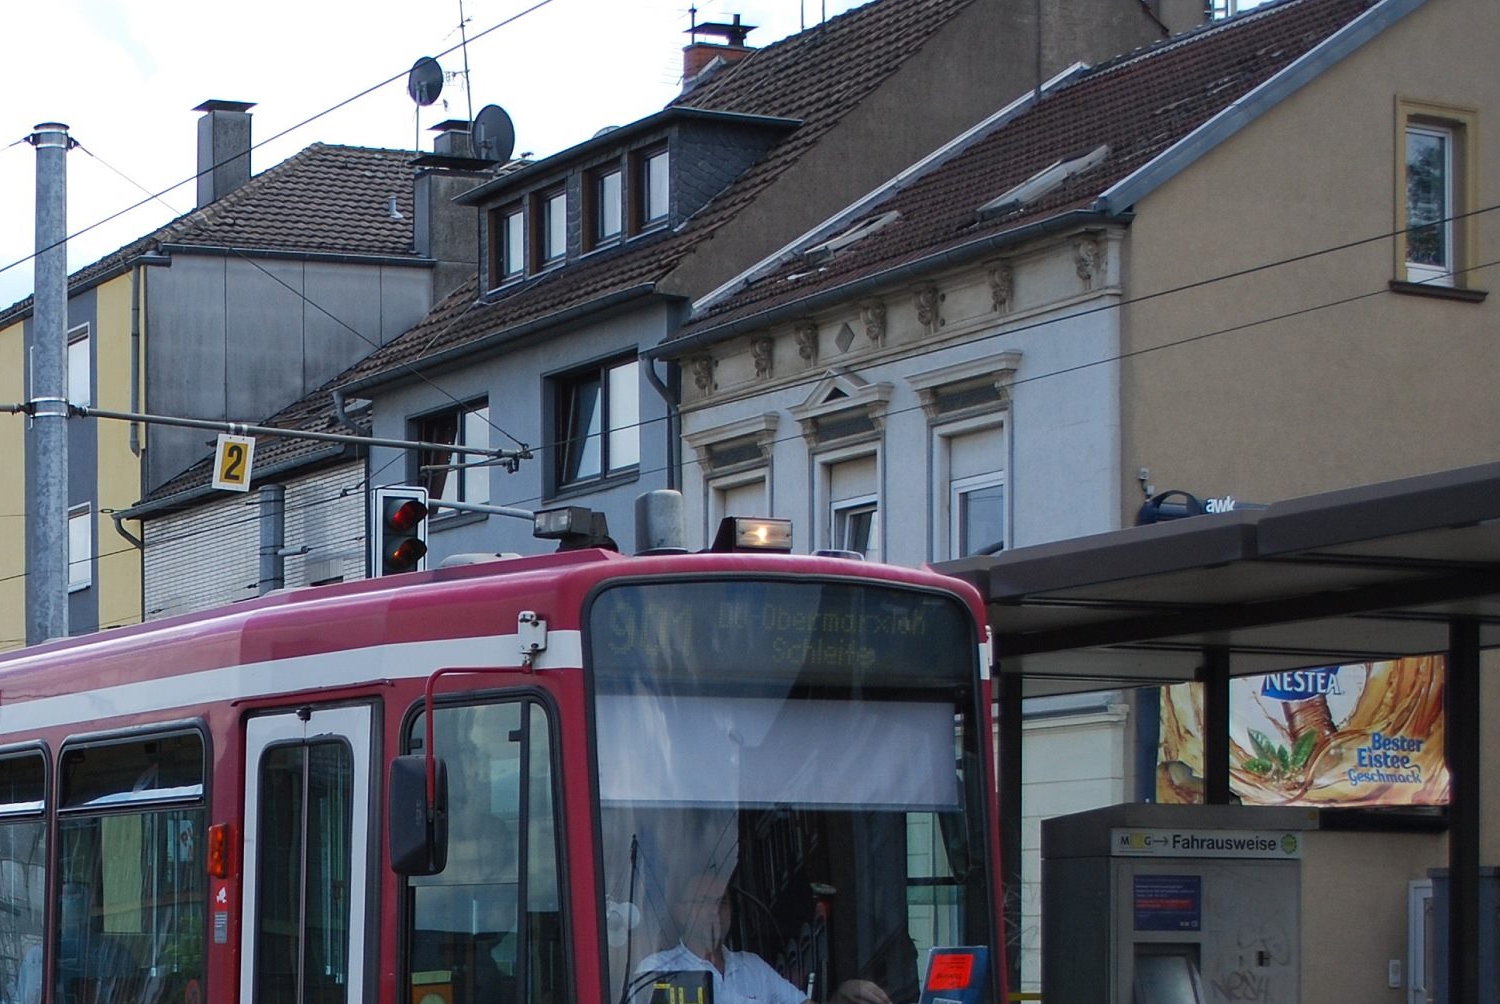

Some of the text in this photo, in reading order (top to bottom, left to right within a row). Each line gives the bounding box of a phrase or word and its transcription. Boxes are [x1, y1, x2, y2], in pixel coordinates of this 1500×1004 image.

[223, 444, 243, 481] 2
[1205, 495, 1236, 514] awk
[1266, 671, 1342, 695] NESTEA
[1371, 732, 1424, 752] Bester
[1357, 746, 1420, 772] Eistee
[1348, 768, 1422, 786] Geschmack
[1171, 834, 1277, 851] Fahrausweise
